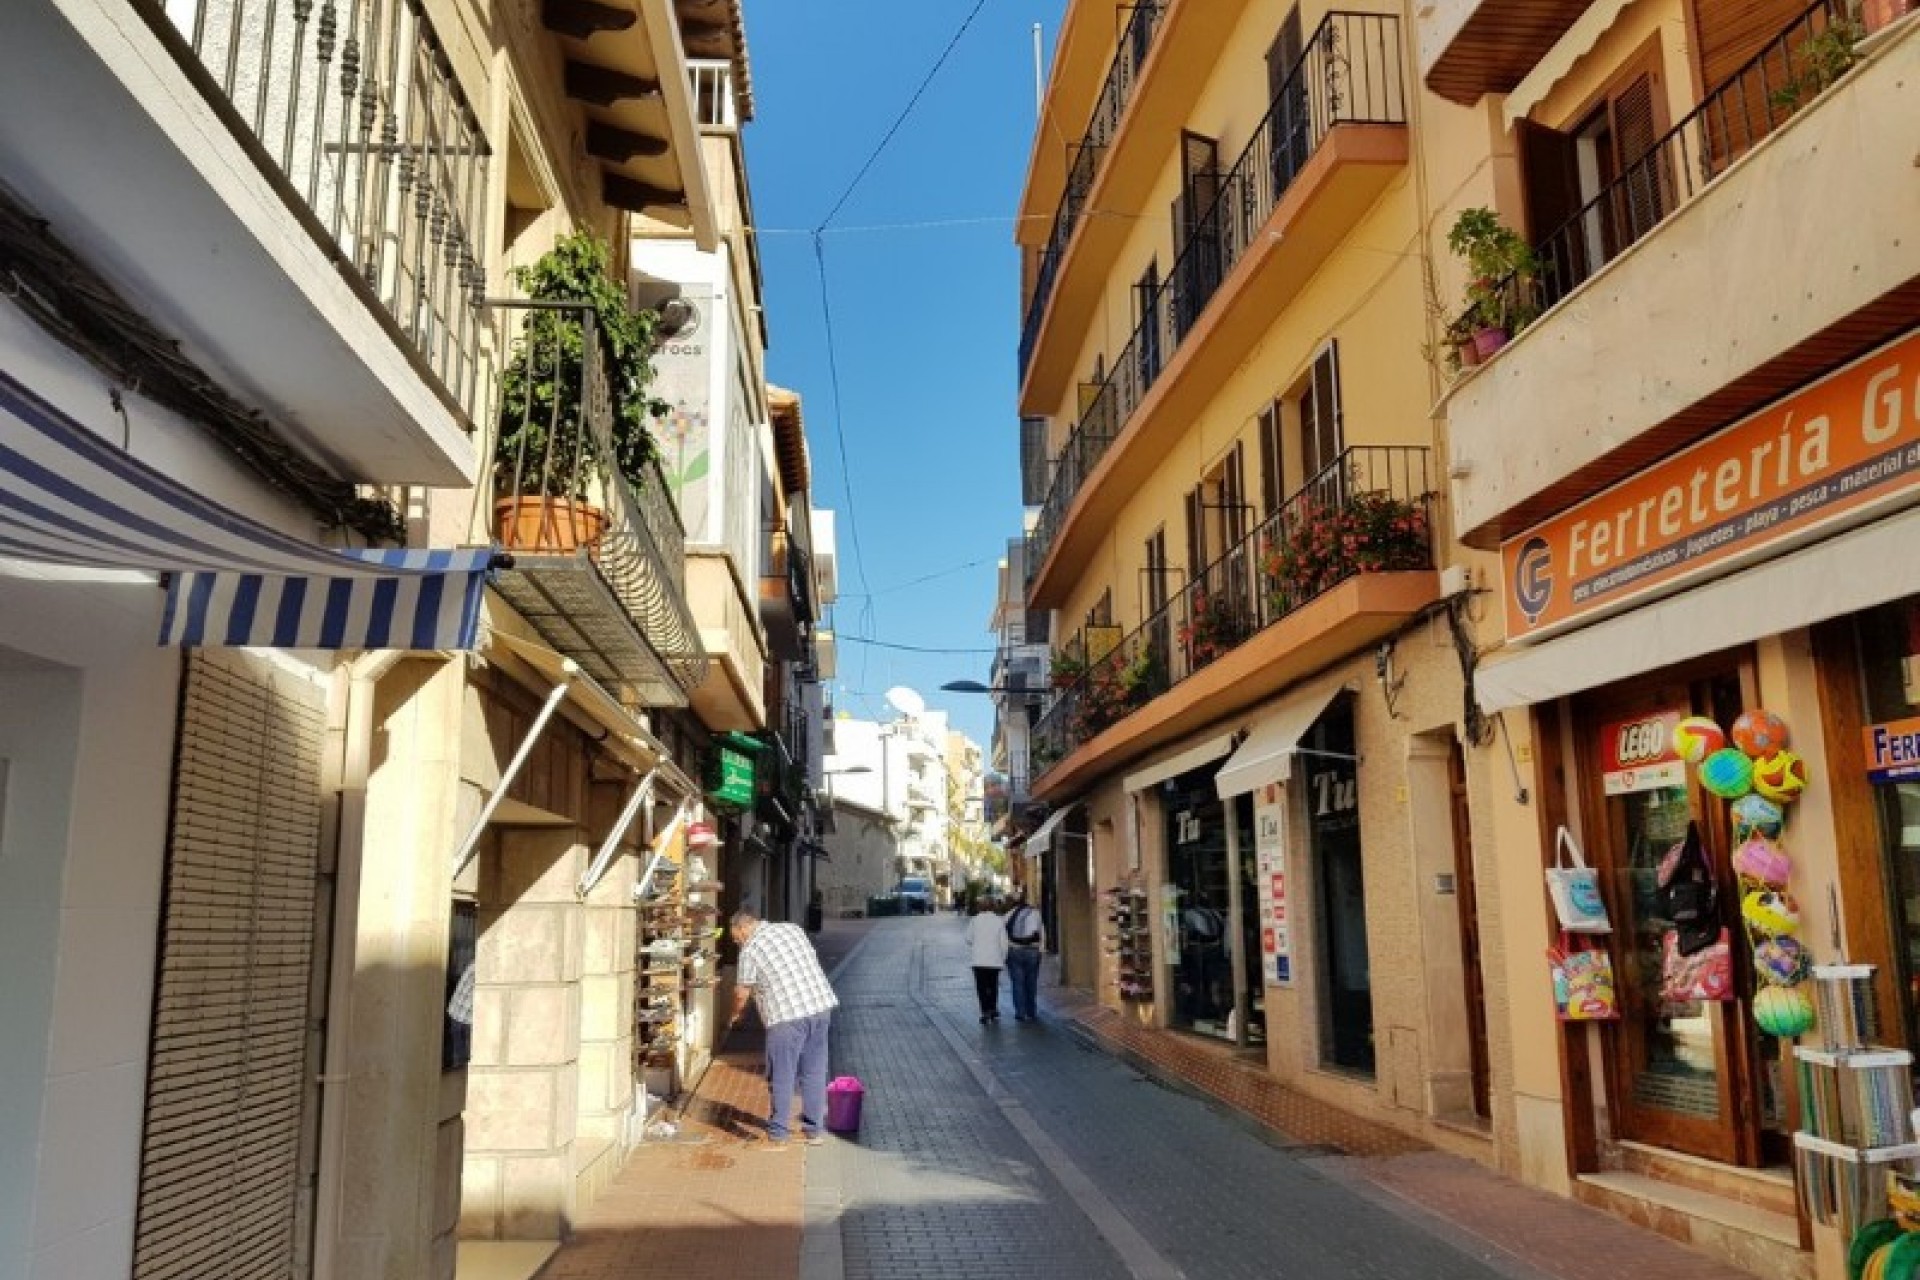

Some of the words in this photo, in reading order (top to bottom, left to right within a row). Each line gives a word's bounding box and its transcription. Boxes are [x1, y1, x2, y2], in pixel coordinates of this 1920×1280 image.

[1569, 411, 1830, 576] Ferretería
[1862, 364, 1920, 443] G
[1744, 507, 1779, 533] playa
[1789, 485, 1828, 515] pesca
[1840, 451, 1902, 492] material
[1619, 720, 1664, 761] LEGO
[1313, 771, 1355, 815] Tu
[1176, 810, 1200, 844] Tu
